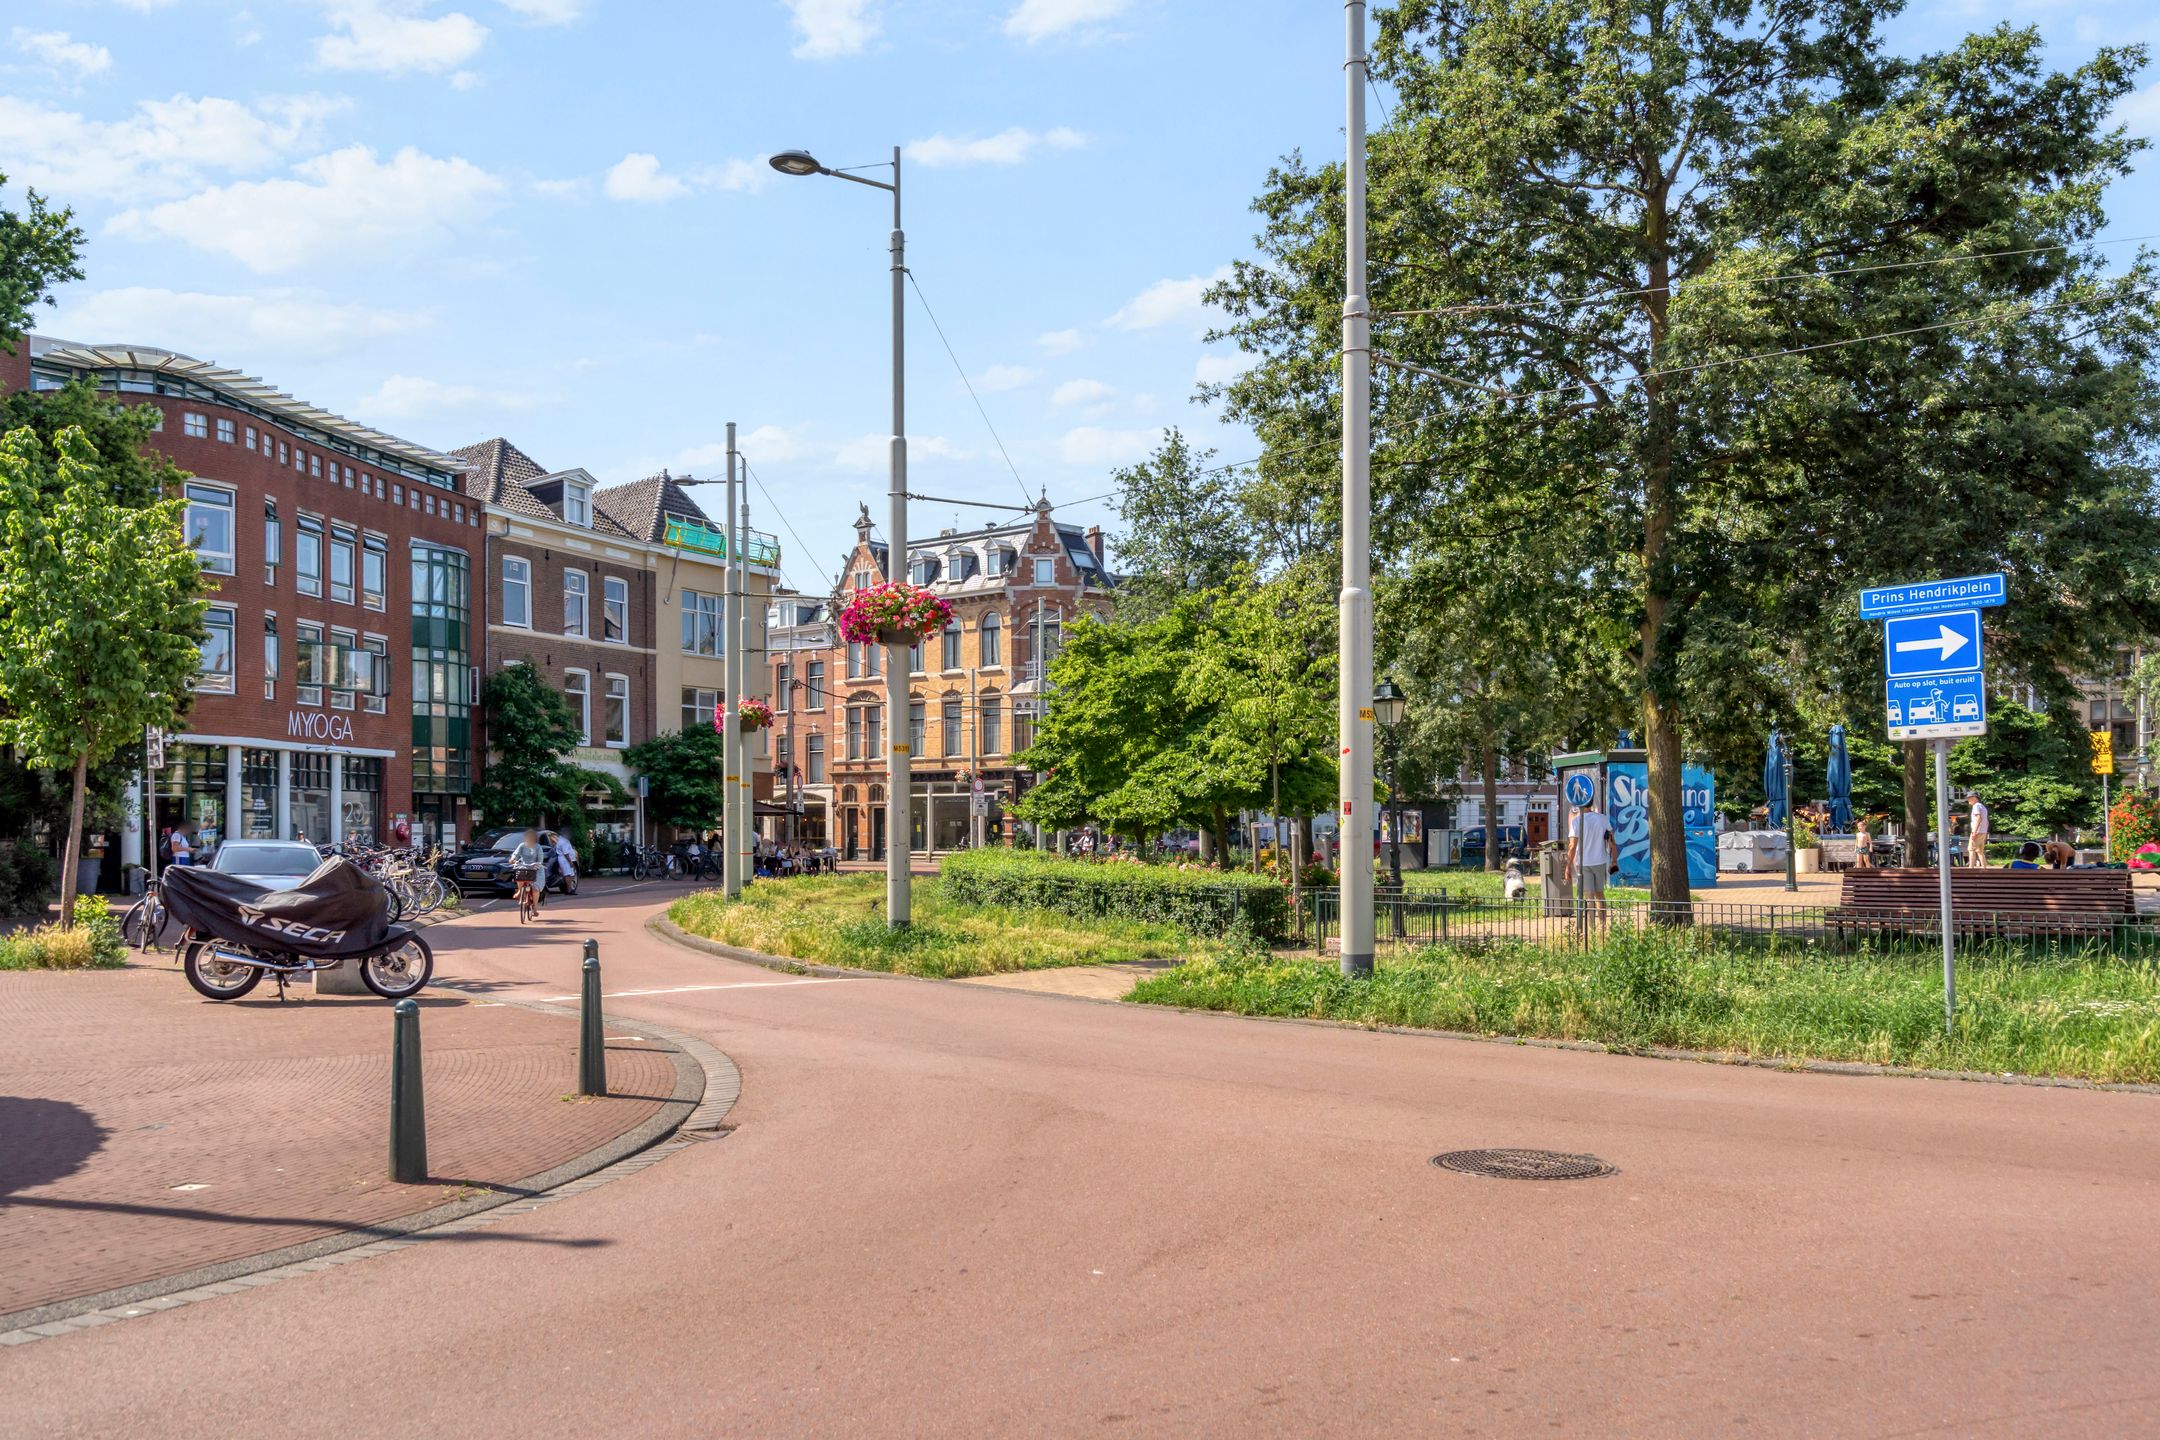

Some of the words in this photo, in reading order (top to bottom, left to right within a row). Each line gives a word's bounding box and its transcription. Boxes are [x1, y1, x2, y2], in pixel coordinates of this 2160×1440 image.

[1872, 592, 1904, 605] Prins
[1909, 581, 1991, 600] Hendrikplein
[1894, 681, 1911, 689] Auto
[1923, 679, 1938, 687] slot,
[1939, 677, 1954, 685] buit
[260, 917, 347, 944] SECA
